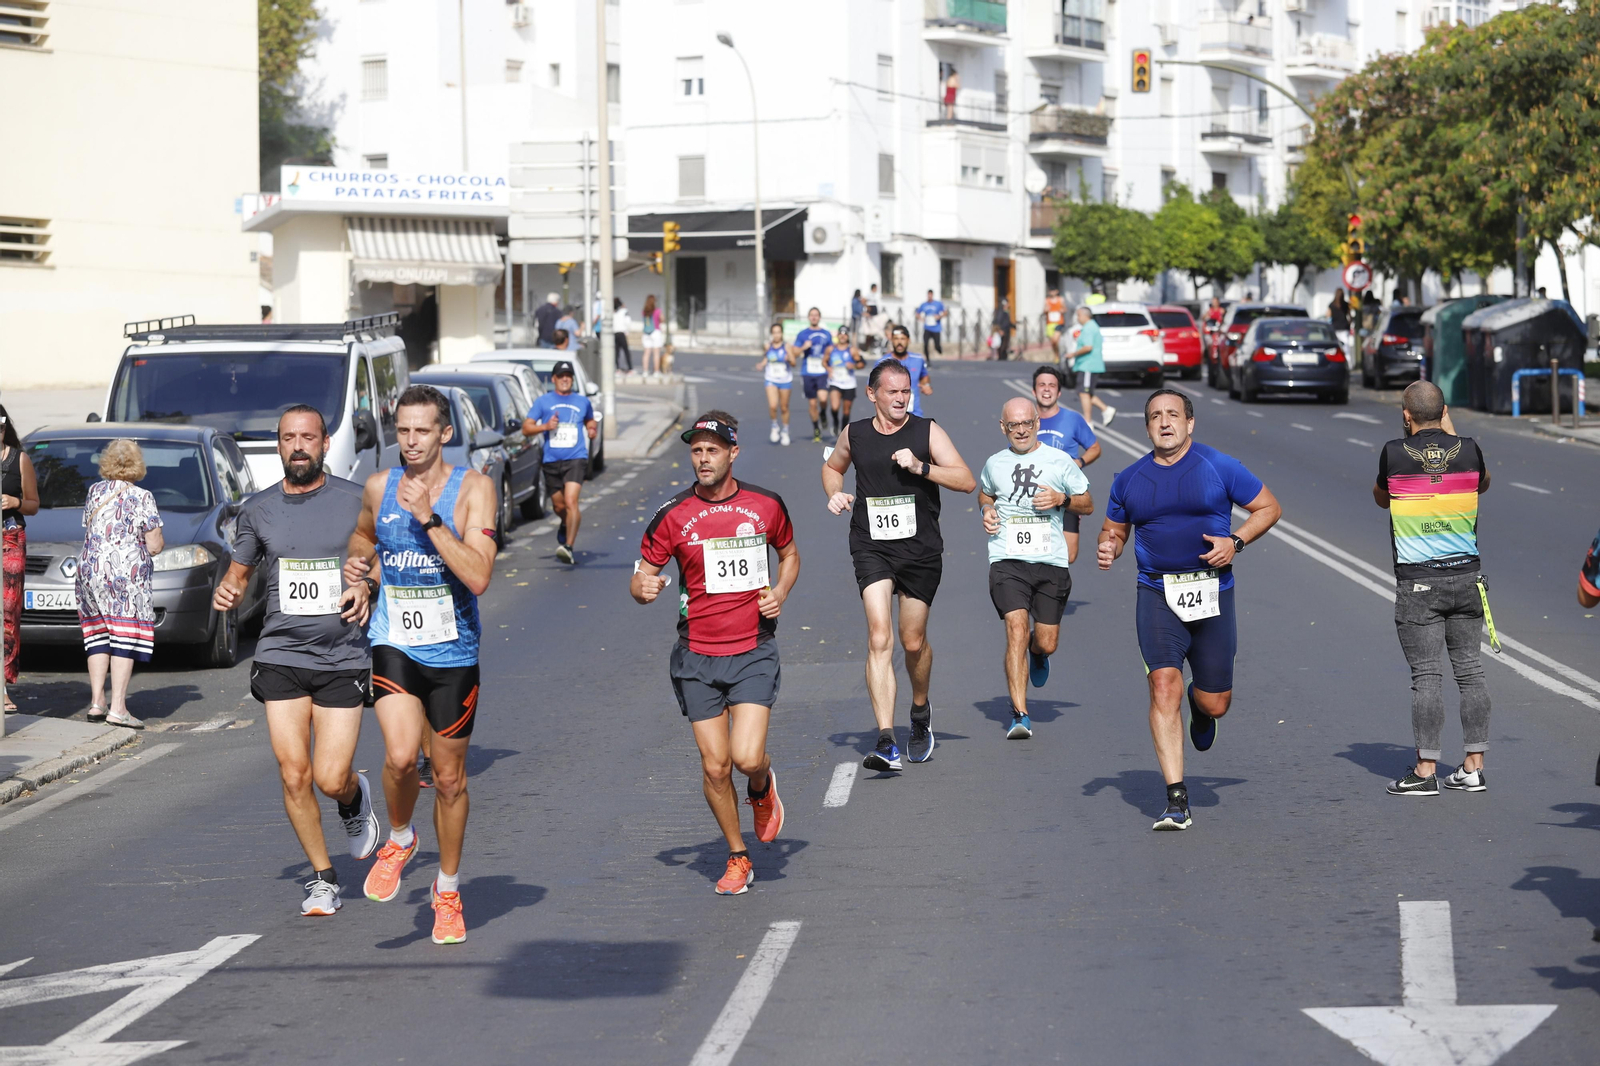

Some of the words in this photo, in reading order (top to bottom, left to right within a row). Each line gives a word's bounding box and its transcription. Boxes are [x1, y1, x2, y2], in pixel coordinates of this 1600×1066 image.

[309, 171, 399, 184] CHURROS
[417, 175, 506, 187] CHOCOLA
[335, 187, 421, 199] PATATAS
[428, 190, 494, 201] FRITAS
[876, 514, 899, 529] 316
[1421, 521, 1451, 530] IBHOLA
[716, 540, 737, 549] VUELTA
[738, 540, 743, 548] A
[744, 537, 763, 547] HUELVA
[1016, 531, 1031, 544] 69
[290, 561, 309, 570] VUELTA
[310, 561, 315, 570] A
[315, 560, 336, 569] HUELVA
[717, 559, 748, 577] 318
[289, 581, 319, 599] 200
[395, 589, 416, 598] VUELTA
[417, 589, 422, 598] A
[422, 588, 447, 598] HUELVA
[37, 593, 71, 607] 9244
[1177, 590, 1203, 608] 424
[402, 611, 423, 629] 60
